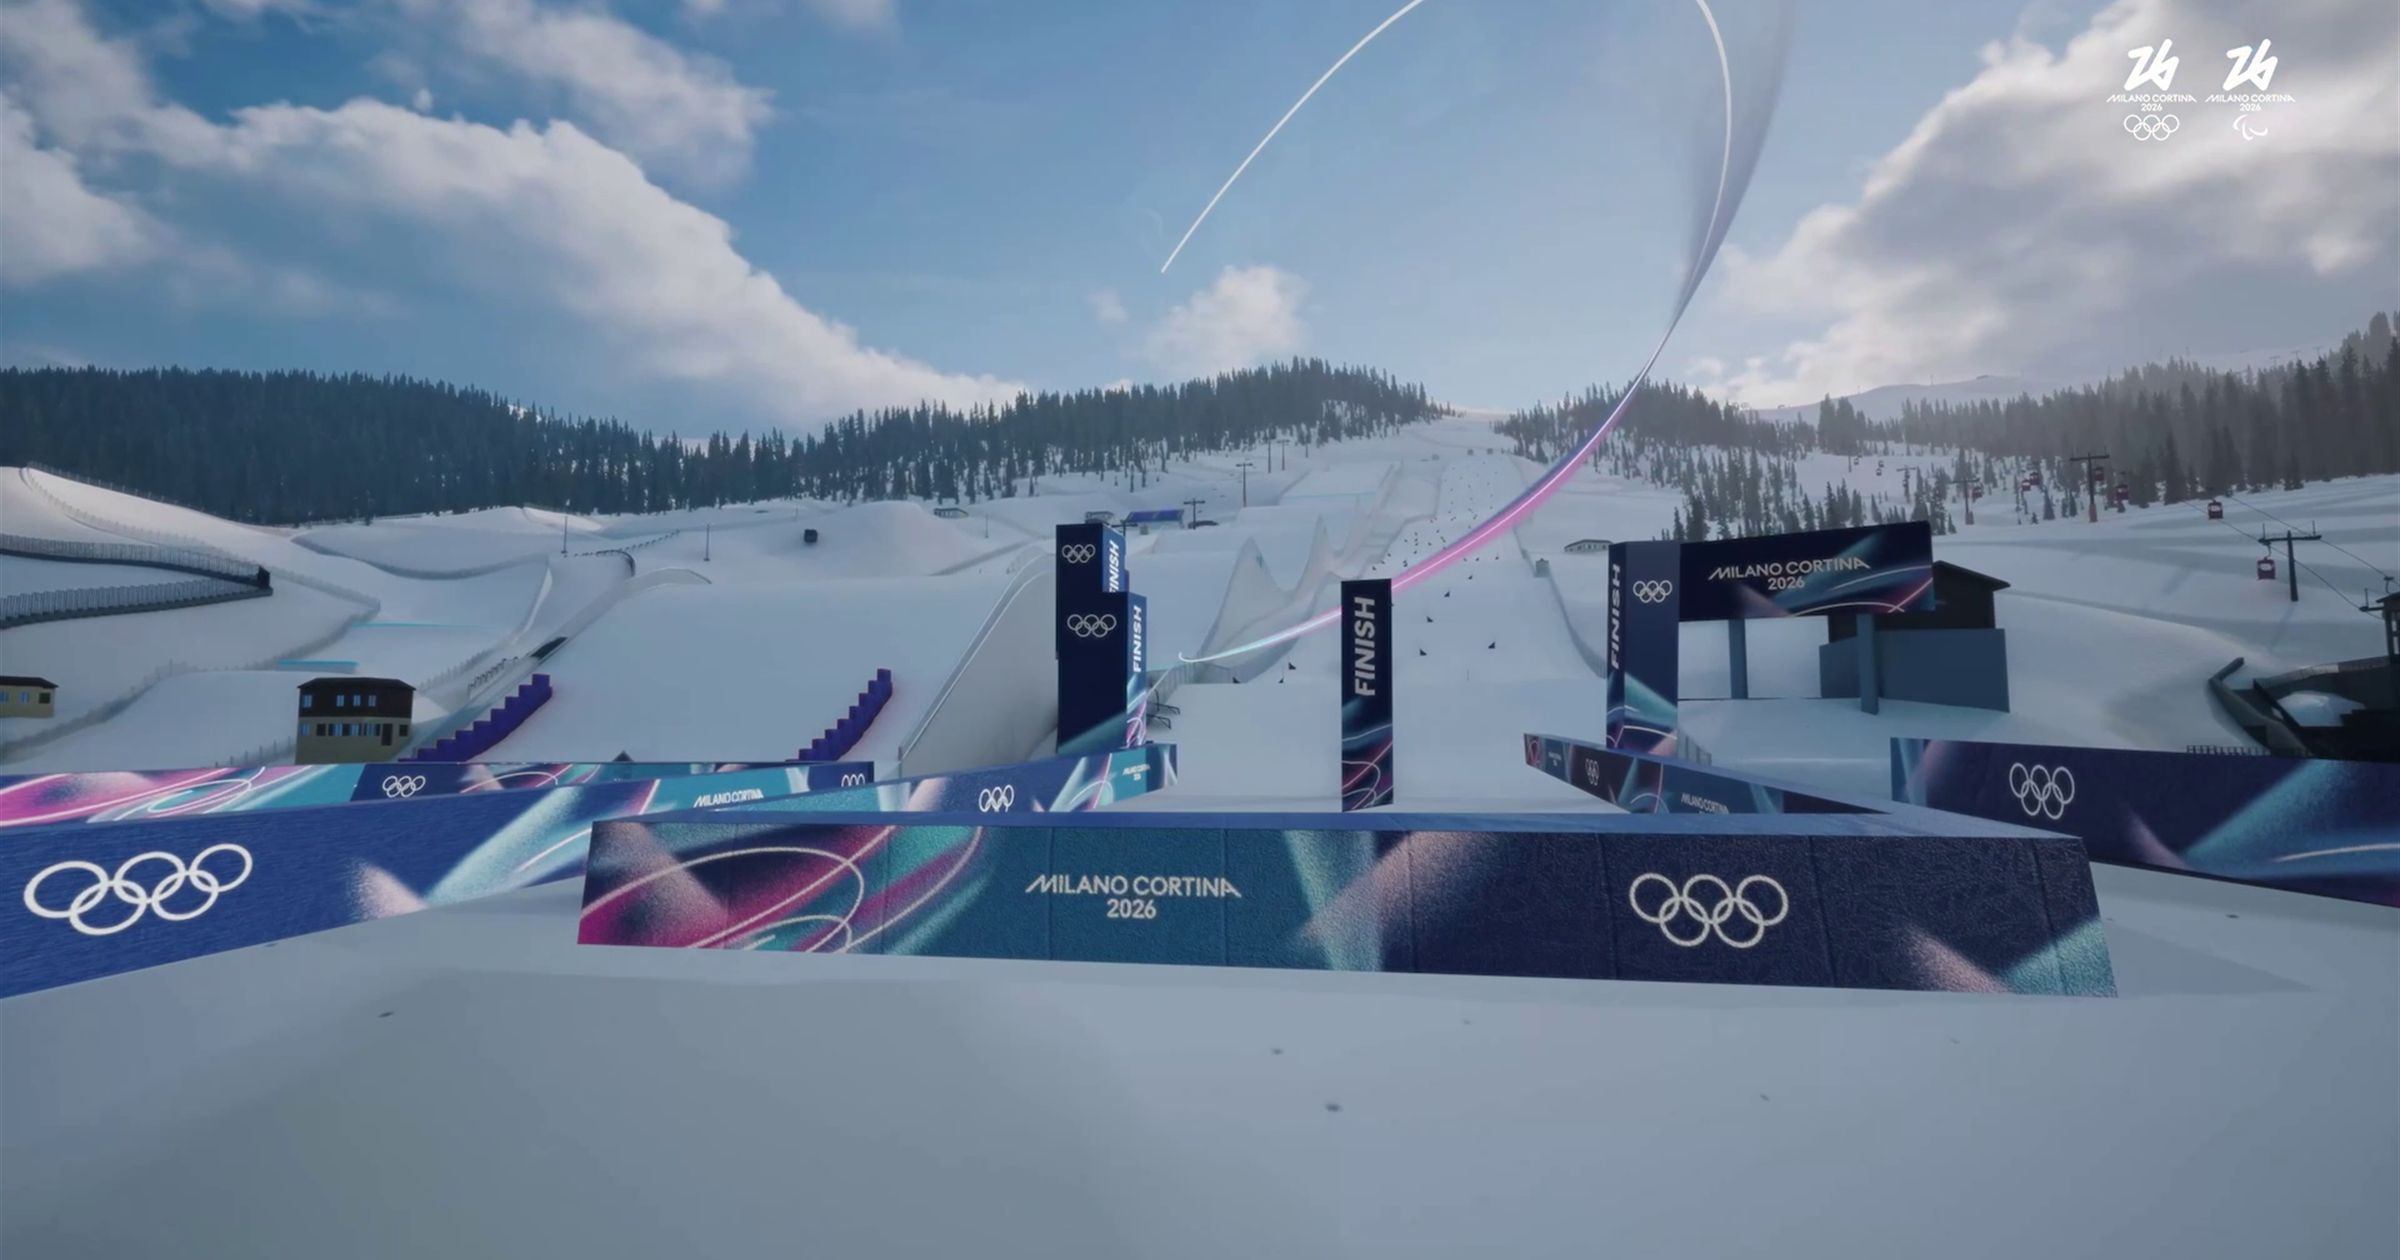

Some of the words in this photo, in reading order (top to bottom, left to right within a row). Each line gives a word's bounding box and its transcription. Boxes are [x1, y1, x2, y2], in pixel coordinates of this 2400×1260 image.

[1708, 562, 1783, 581] MILANO
[1785, 556, 1871, 575] CORTINA
[1767, 576, 1806, 591] 2026
[1610, 563, 1621, 669] FINISH
[1132, 605, 1142, 673] FINISH
[1354, 596, 1376, 696] FINISH
[693, 791, 730, 808] MILANO
[731, 788, 764, 803] CORTINA
[1025, 874, 1129, 895] MILANO
[1132, 875, 1242, 898] CORTINA
[1106, 898, 1157, 919] 2026
